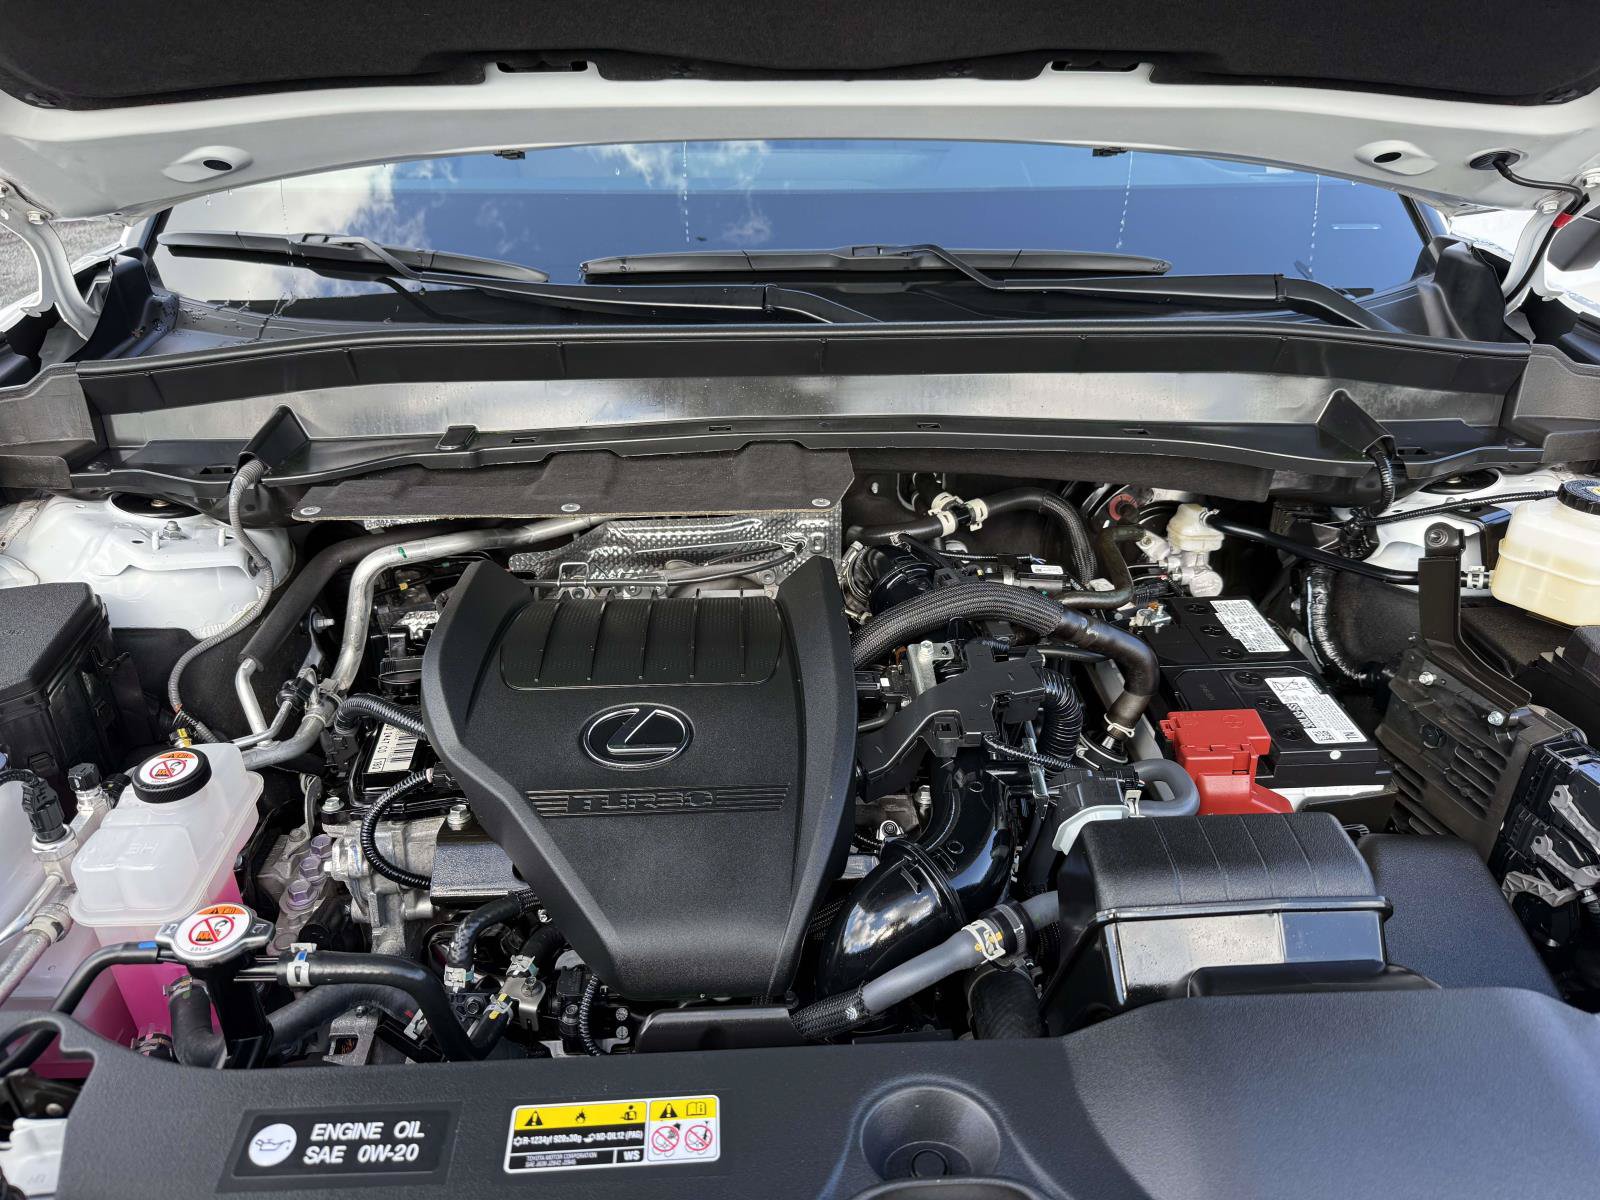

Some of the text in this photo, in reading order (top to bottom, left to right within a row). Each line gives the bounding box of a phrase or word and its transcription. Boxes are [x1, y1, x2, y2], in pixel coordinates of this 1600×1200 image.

[568, 790, 714, 811] TURBO
[310, 1120, 425, 1141] ENGINE OIL
[303, 1143, 420, 1165] SAE 0W-20
[623, 1150, 641, 1161] WS
